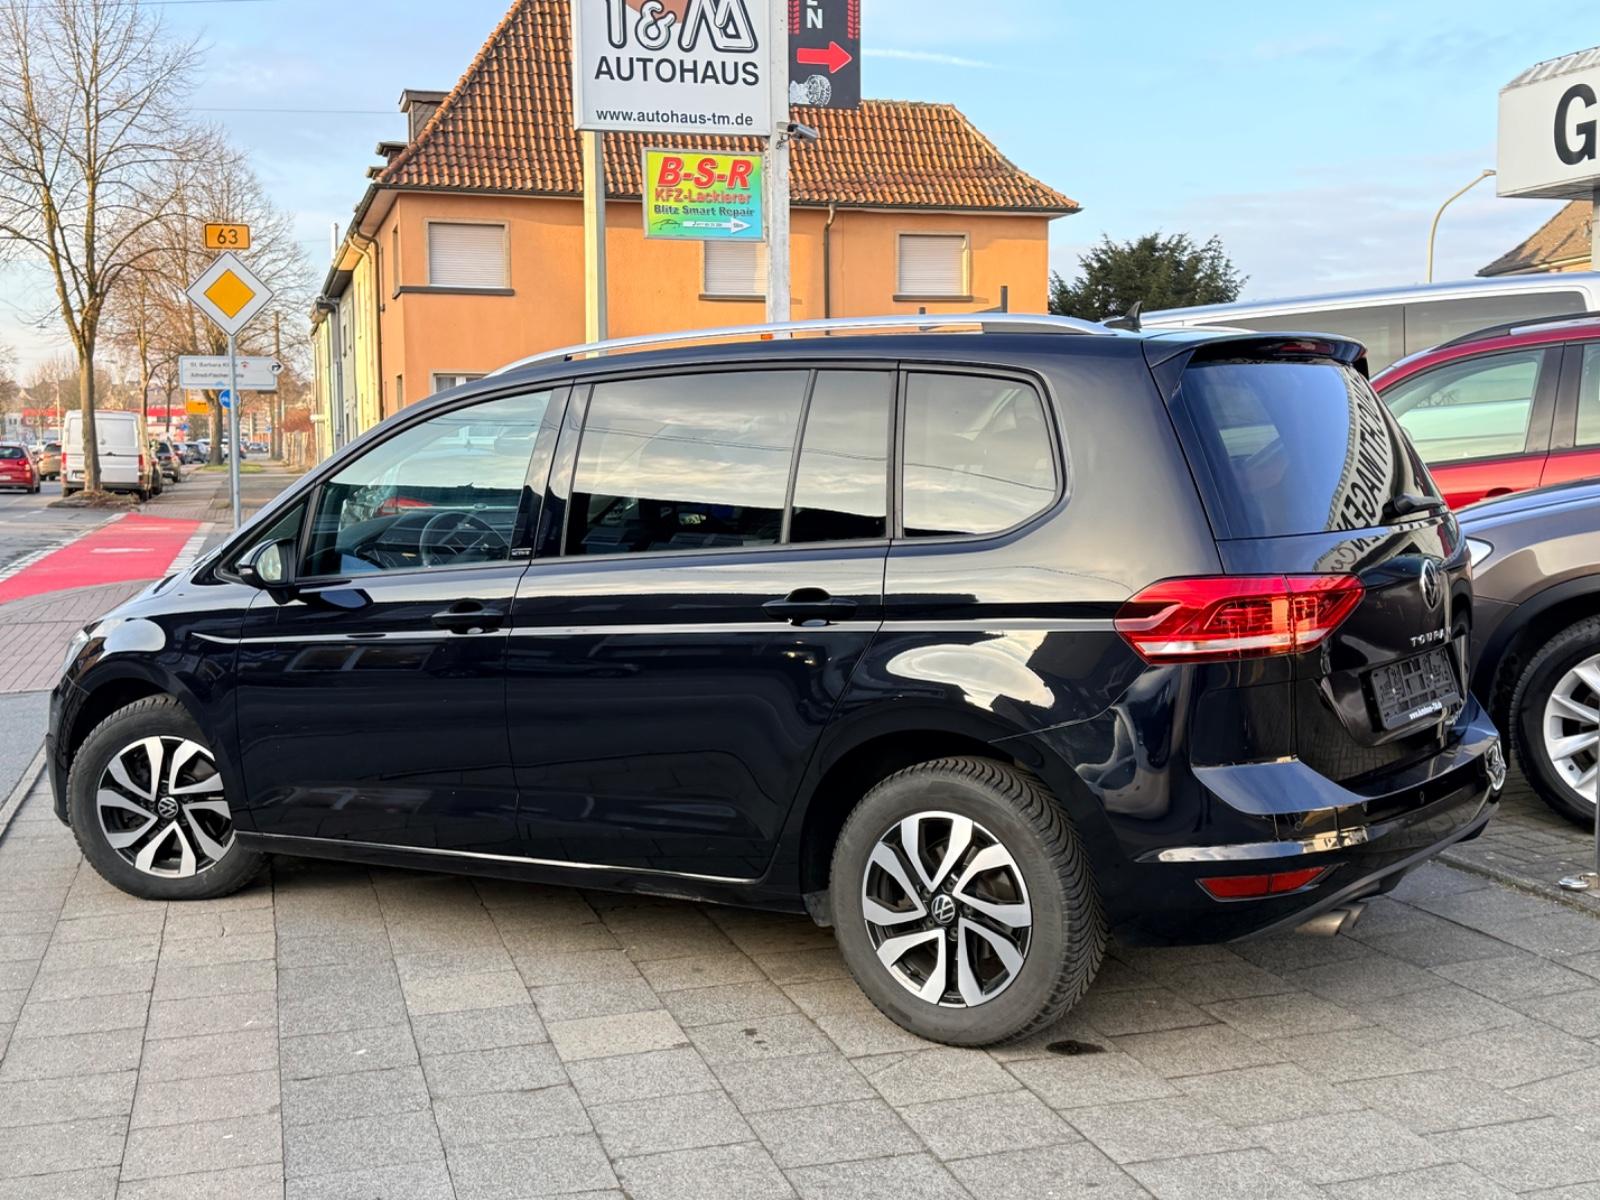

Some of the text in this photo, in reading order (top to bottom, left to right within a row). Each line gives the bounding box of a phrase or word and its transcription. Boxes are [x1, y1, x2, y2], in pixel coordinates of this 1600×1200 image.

[595, 56, 760, 86] AUTOHAUS
[596, 109, 754, 127] www.autohaus-tm.de
[1553, 83, 1597, 165] G
[657, 156, 754, 190] B-S-R
[655, 188, 752, 204] KFZ-Lackierer
[654, 204, 754, 218] Blitz Smart Repair
[217, 228, 239, 246] 63
